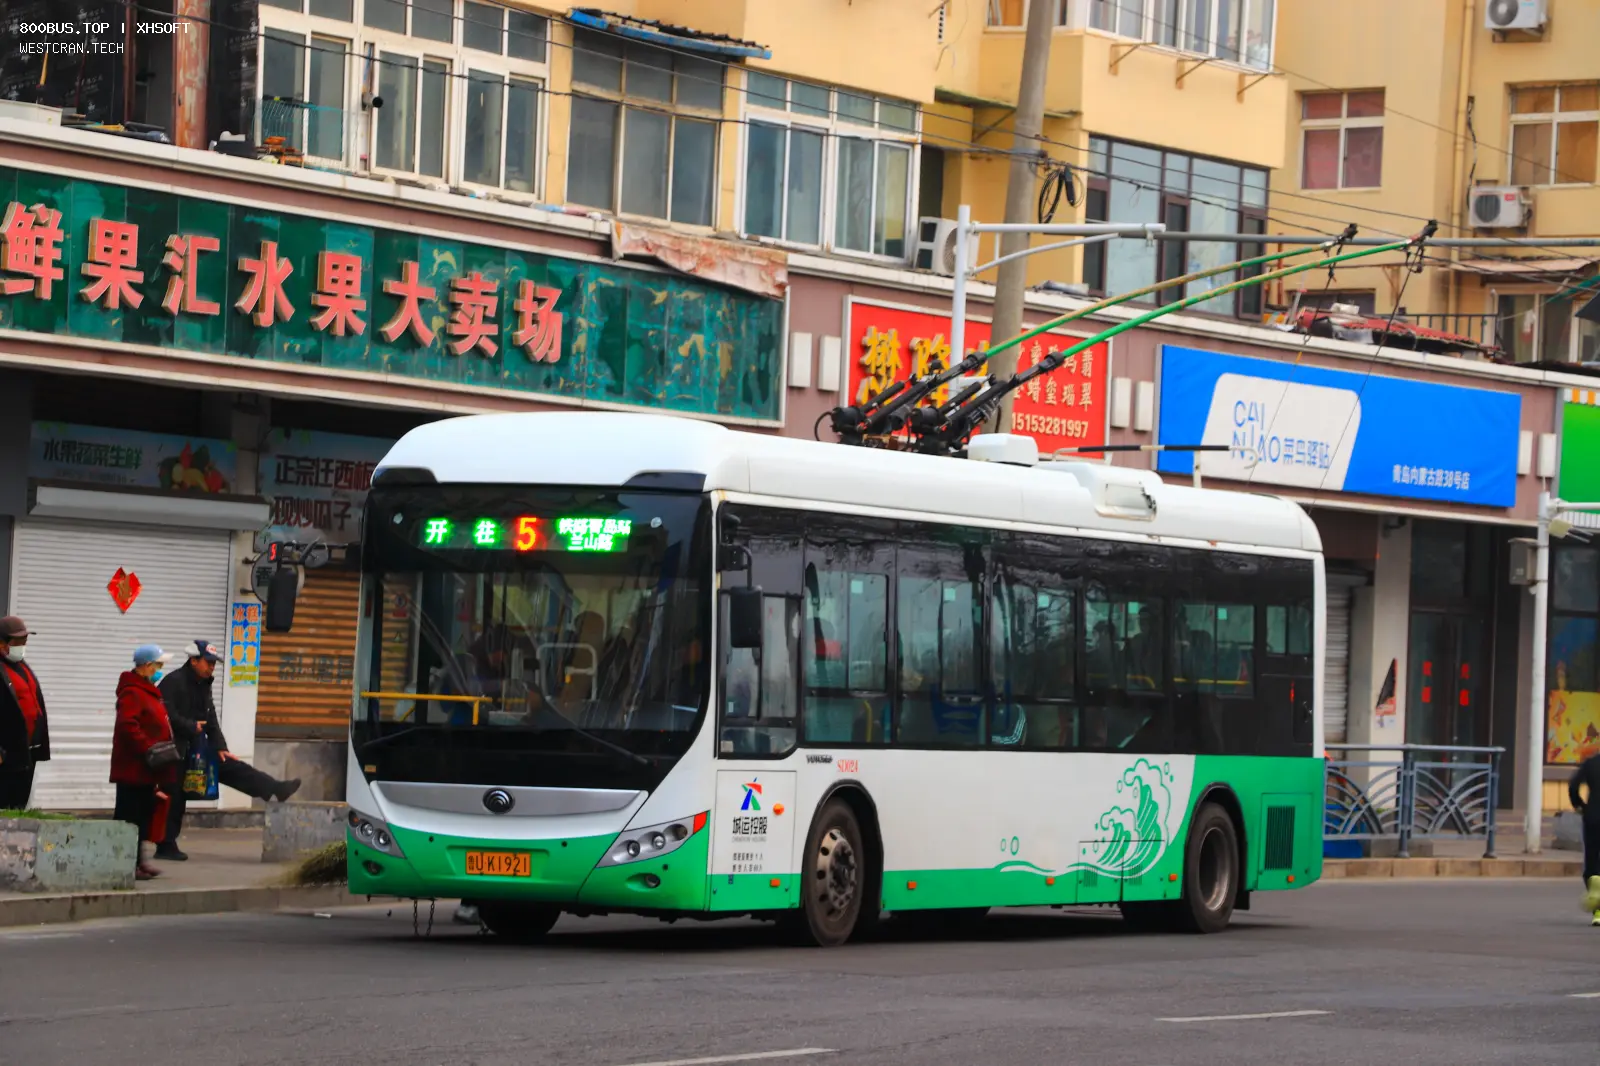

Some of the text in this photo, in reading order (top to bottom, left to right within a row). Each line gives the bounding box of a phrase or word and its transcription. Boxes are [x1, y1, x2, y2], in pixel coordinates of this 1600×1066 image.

[0, 201, 565, 364] 鲜果汇水果大卖场
[1011, 411, 1089, 440] 15153281997
[1233, 399, 1265, 430] CAI
[42, 438, 143, 470] 水果蔬菜生鲜
[1283, 437, 1331, 469] 菜鸟驿站
[516, 517, 538, 551] 5
[732, 816, 768, 835] 城运控股
